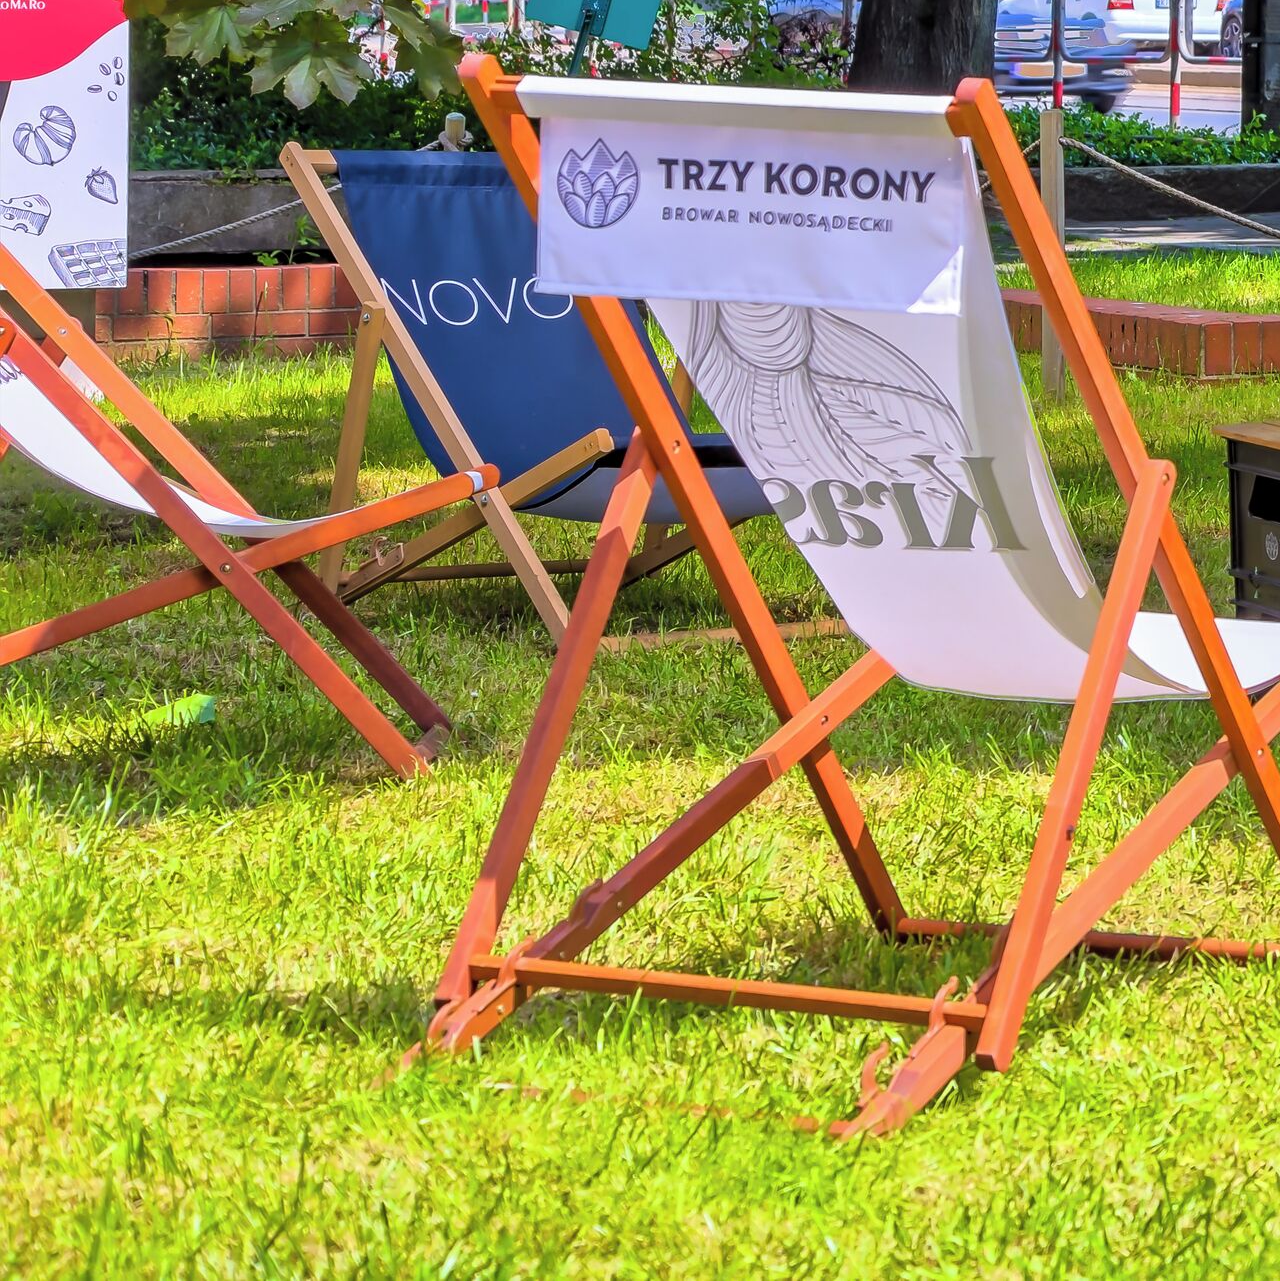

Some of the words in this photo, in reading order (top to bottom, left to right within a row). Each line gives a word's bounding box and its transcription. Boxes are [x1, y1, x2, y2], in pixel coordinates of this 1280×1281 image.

[657, 158, 755, 193] TRZY
[764, 162, 936, 204] KORONY
[662, 206, 739, 223] BROWAR
[748, 211, 893, 232] NOWOSĄDECKI
[380, 278, 574, 326] NOVO
